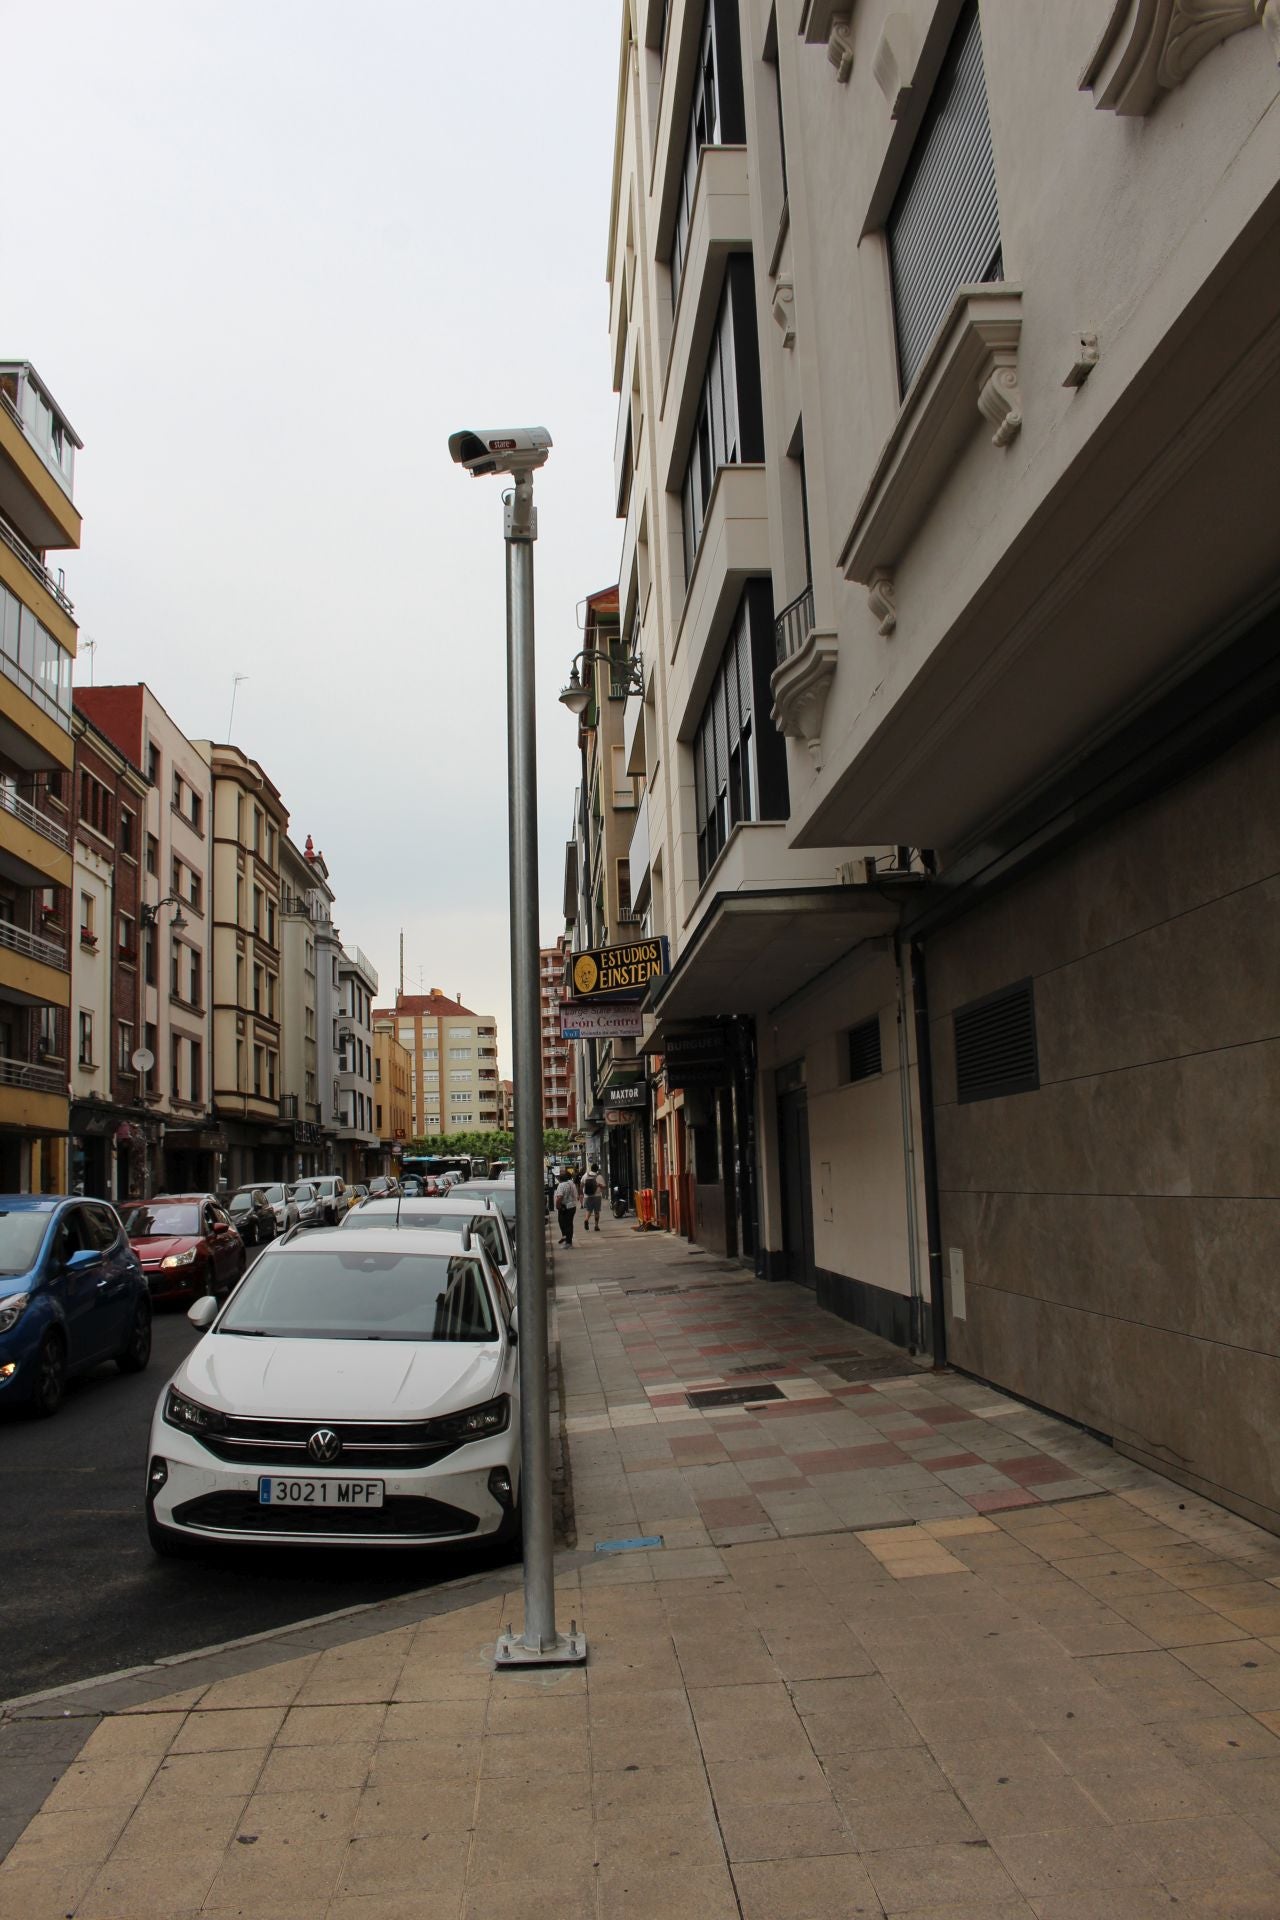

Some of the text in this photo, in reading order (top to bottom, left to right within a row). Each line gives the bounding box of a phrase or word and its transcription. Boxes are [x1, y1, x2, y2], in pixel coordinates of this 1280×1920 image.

[600, 943, 657, 969] ESTUDIOS
[599, 960, 662, 989] EINSTEIN
[564, 1016, 638, 1028] León Centro
[610, 1088, 639, 1100] MAXTOR
[276, 1482, 327, 1502] 3021
[337, 1484, 378, 1503] MPF
